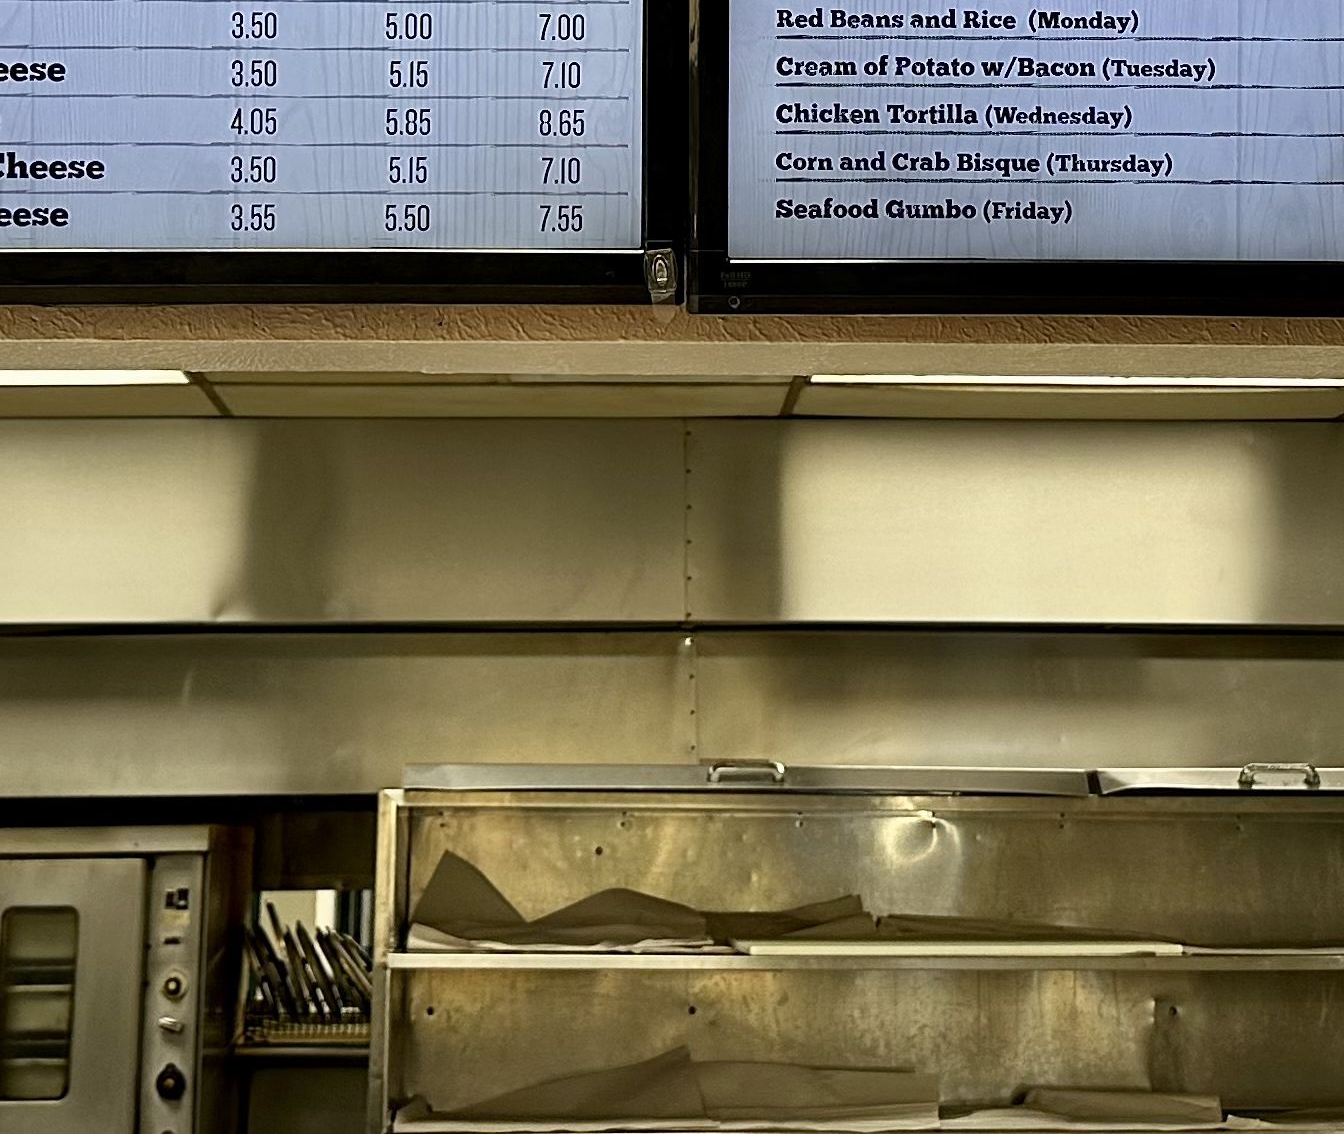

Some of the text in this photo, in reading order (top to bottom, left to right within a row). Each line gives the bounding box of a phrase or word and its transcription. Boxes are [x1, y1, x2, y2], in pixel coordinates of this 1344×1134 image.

[231, 204, 276, 231] 3.55
[385, 204, 430, 232] 5.50
[539, 205, 583, 232] 7.55
